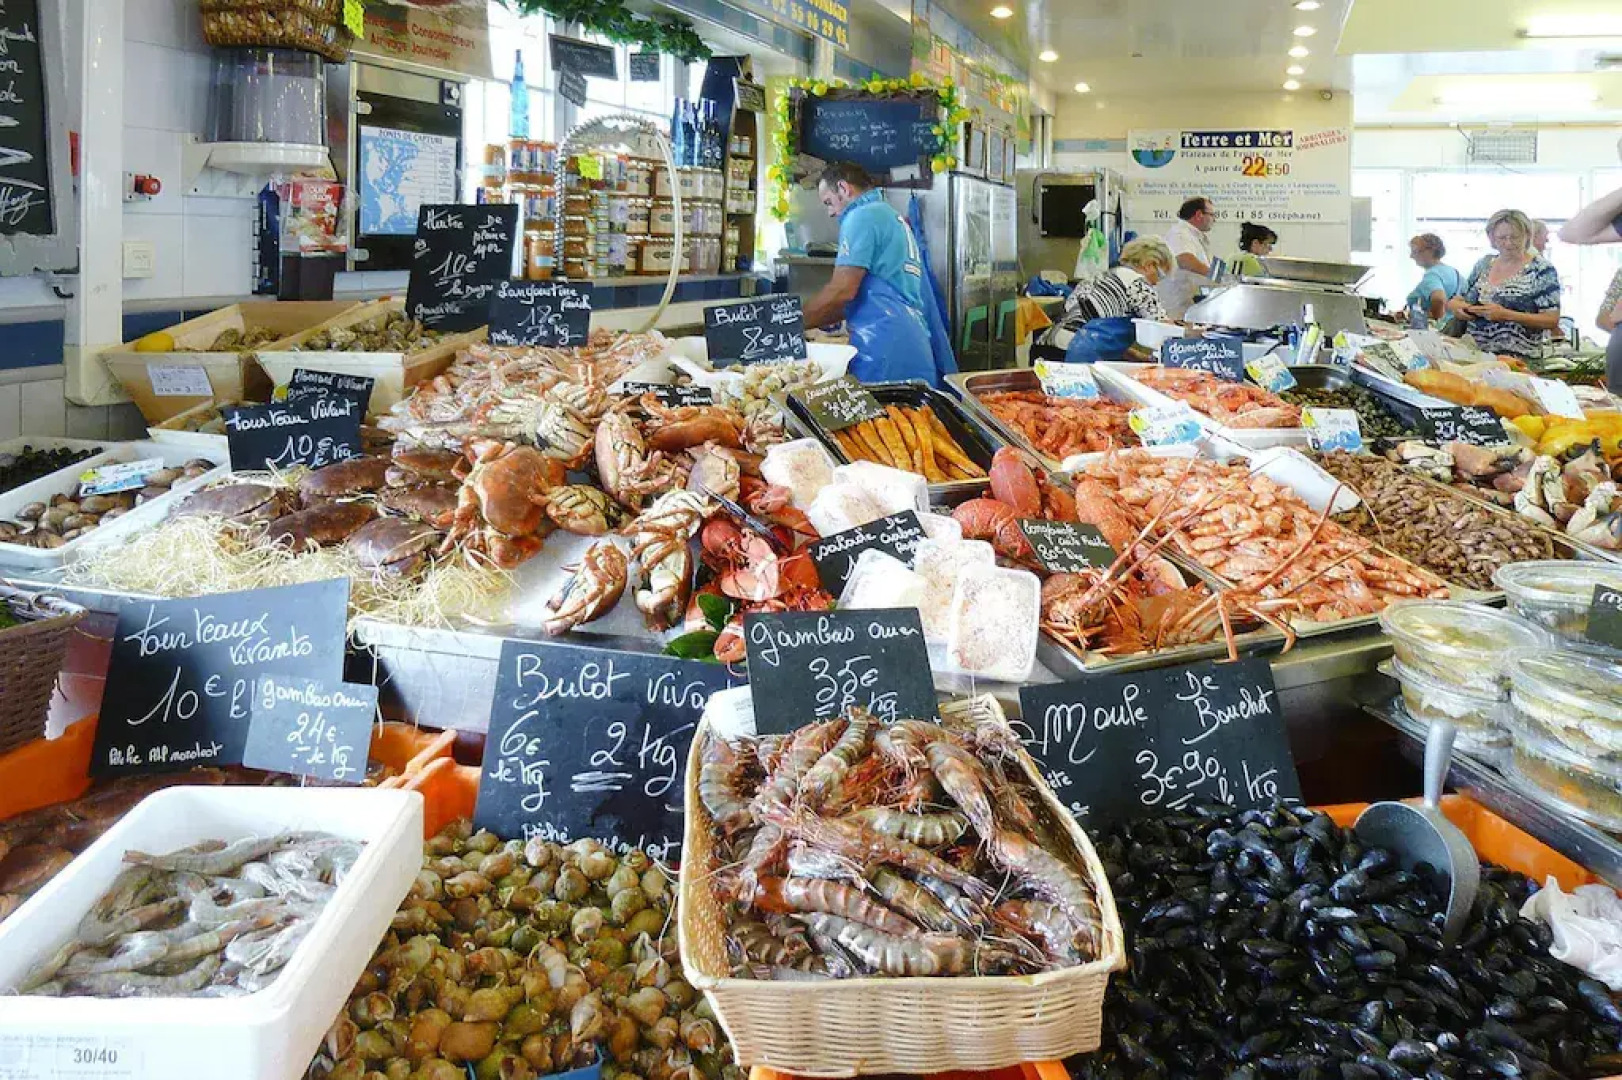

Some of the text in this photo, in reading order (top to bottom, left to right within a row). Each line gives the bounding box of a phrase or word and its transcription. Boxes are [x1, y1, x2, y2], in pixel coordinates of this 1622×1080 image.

[1181, 150, 1216, 158] Plateaux
[1219, 150, 1229, 158] de
[1263, 150, 1273, 158] de
[1277, 150, 1293, 158] Mer
[1183, 131, 1292, 148] Terre et Mer
[1194, 164, 1201, 172] A
[1203, 164, 1229, 173] partir
[1153, 210, 1172, 219] Tél.
[1250, 210, 1263, 219] 85
[429, 251, 478, 275] 10€
[512, 653, 731, 710] Bulot Viva
[808, 654, 880, 704] 35€
[1176, 670, 1220, 701] De
[126, 665, 227, 726] 10€
[500, 710, 542, 757] 6€
[1041, 683, 1273, 764] Moule Bouchot
[589, 721, 625, 767] 2
[73, 1047, 119, 1065] 30/40
